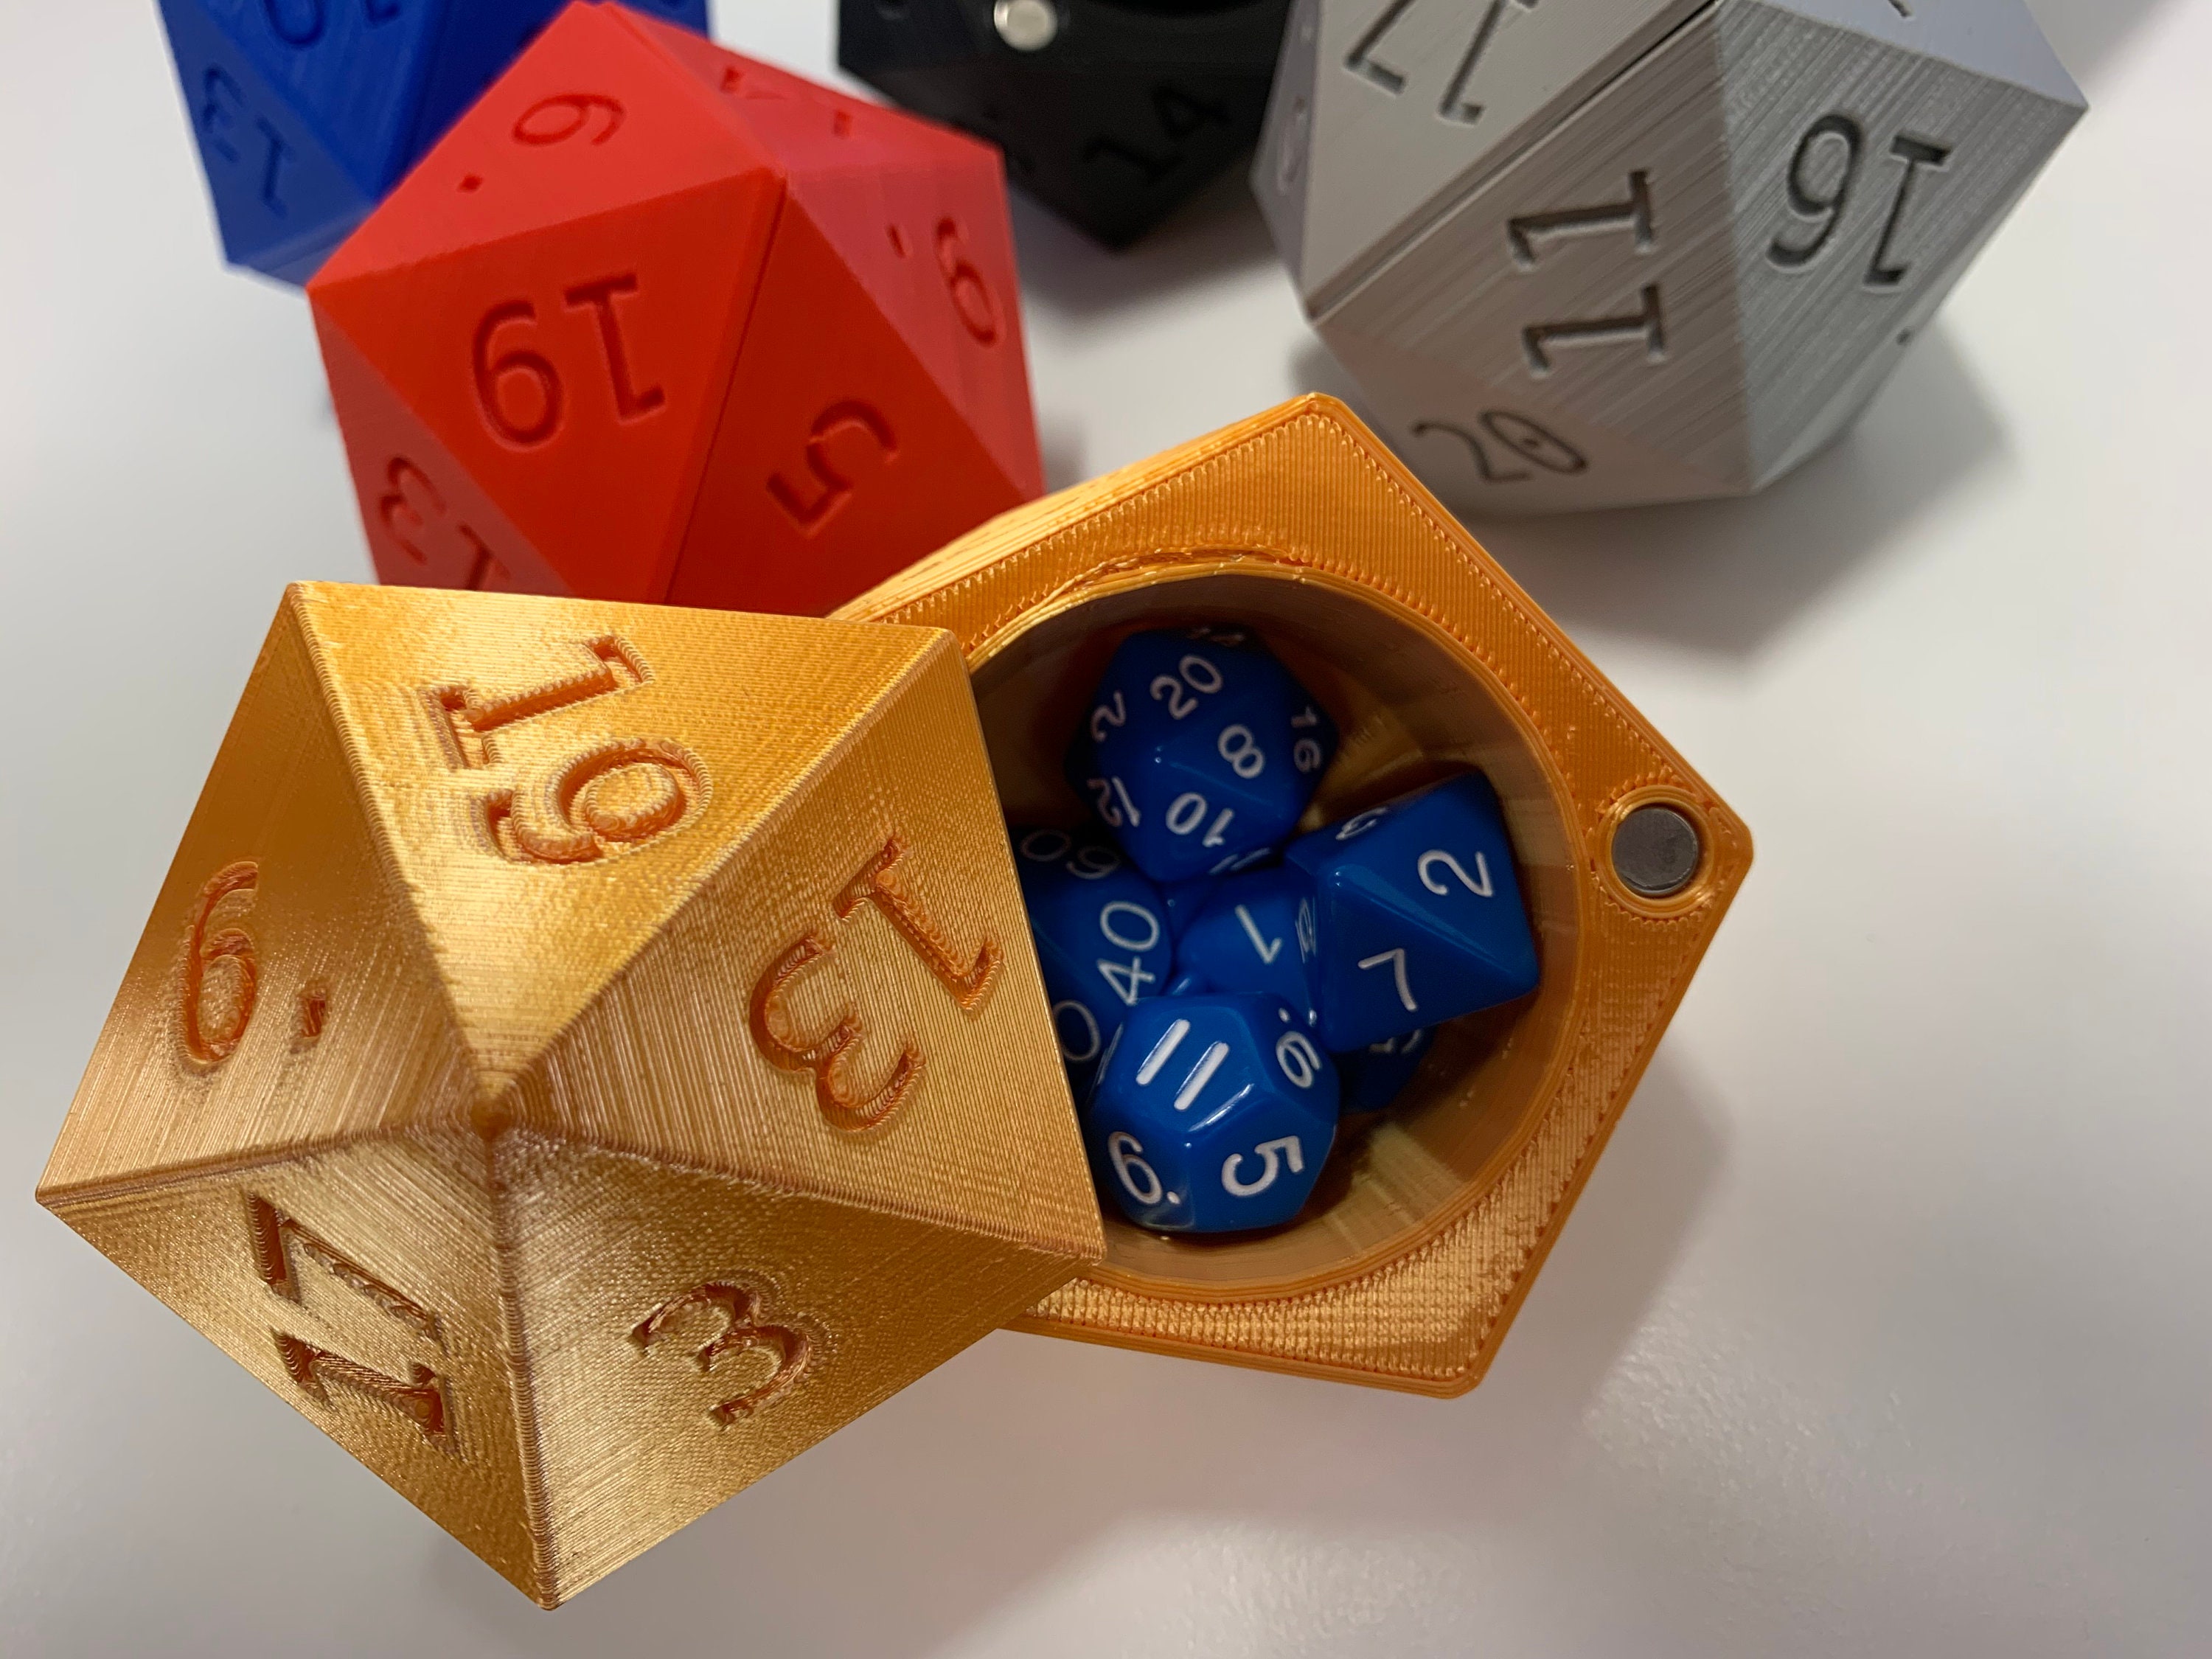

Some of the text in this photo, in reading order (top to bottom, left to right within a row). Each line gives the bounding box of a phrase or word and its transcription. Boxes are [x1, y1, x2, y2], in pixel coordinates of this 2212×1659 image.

[1082, 85, 1231, 184] 14
[1767, 108, 1953, 288] 16
[1506, 168, 1666, 379] 11
[472, 273, 666, 450] 19
[766, 400, 899, 535] 5
[1412, 408, 1589, 483] 20
[1091, 690, 1126, 742] 2
[1150, 655, 1223, 720] 20
[420, 631, 714, 867] 19
[1218, 724, 1266, 779] 8
[1166, 793, 1234, 847] 10
[1417, 849, 1494, 899] 2
[747, 836, 1006, 1134] 13
[1097, 901, 1160, 1005] 40
[1357, 947, 1419, 1012] 7
[1135, 1018, 1230, 1110] 11
[1221, 1135, 1305, 1197] 5
[629, 1276, 821, 1433] 3
